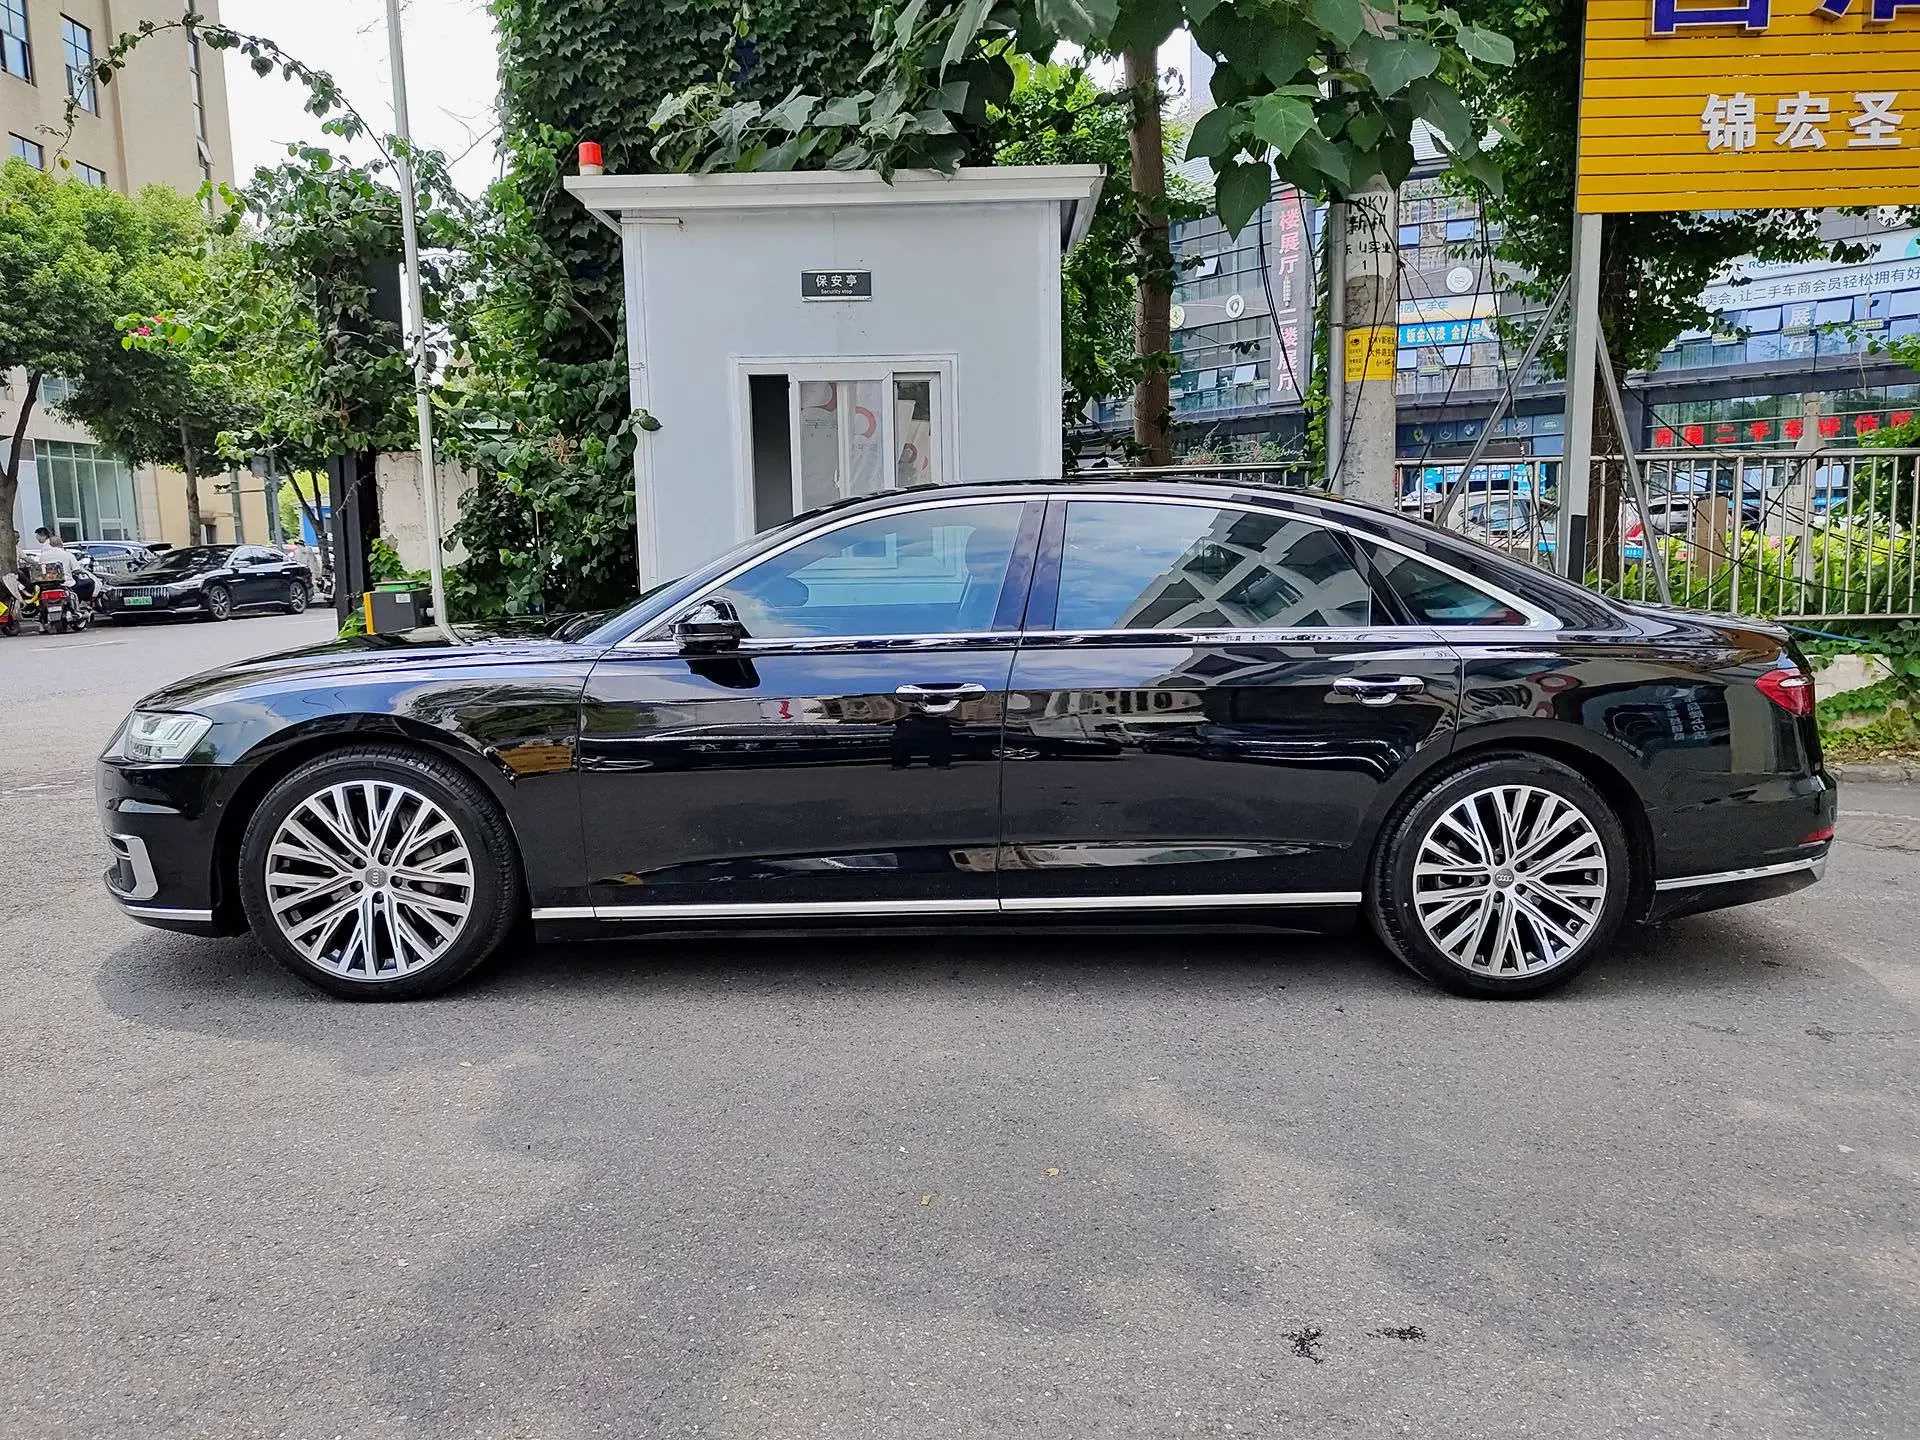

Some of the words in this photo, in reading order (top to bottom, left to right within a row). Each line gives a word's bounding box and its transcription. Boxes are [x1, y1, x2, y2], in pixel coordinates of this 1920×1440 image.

[1701, 91, 1905, 151] 锦宏圣
[815, 274, 857, 287] 保安亭
